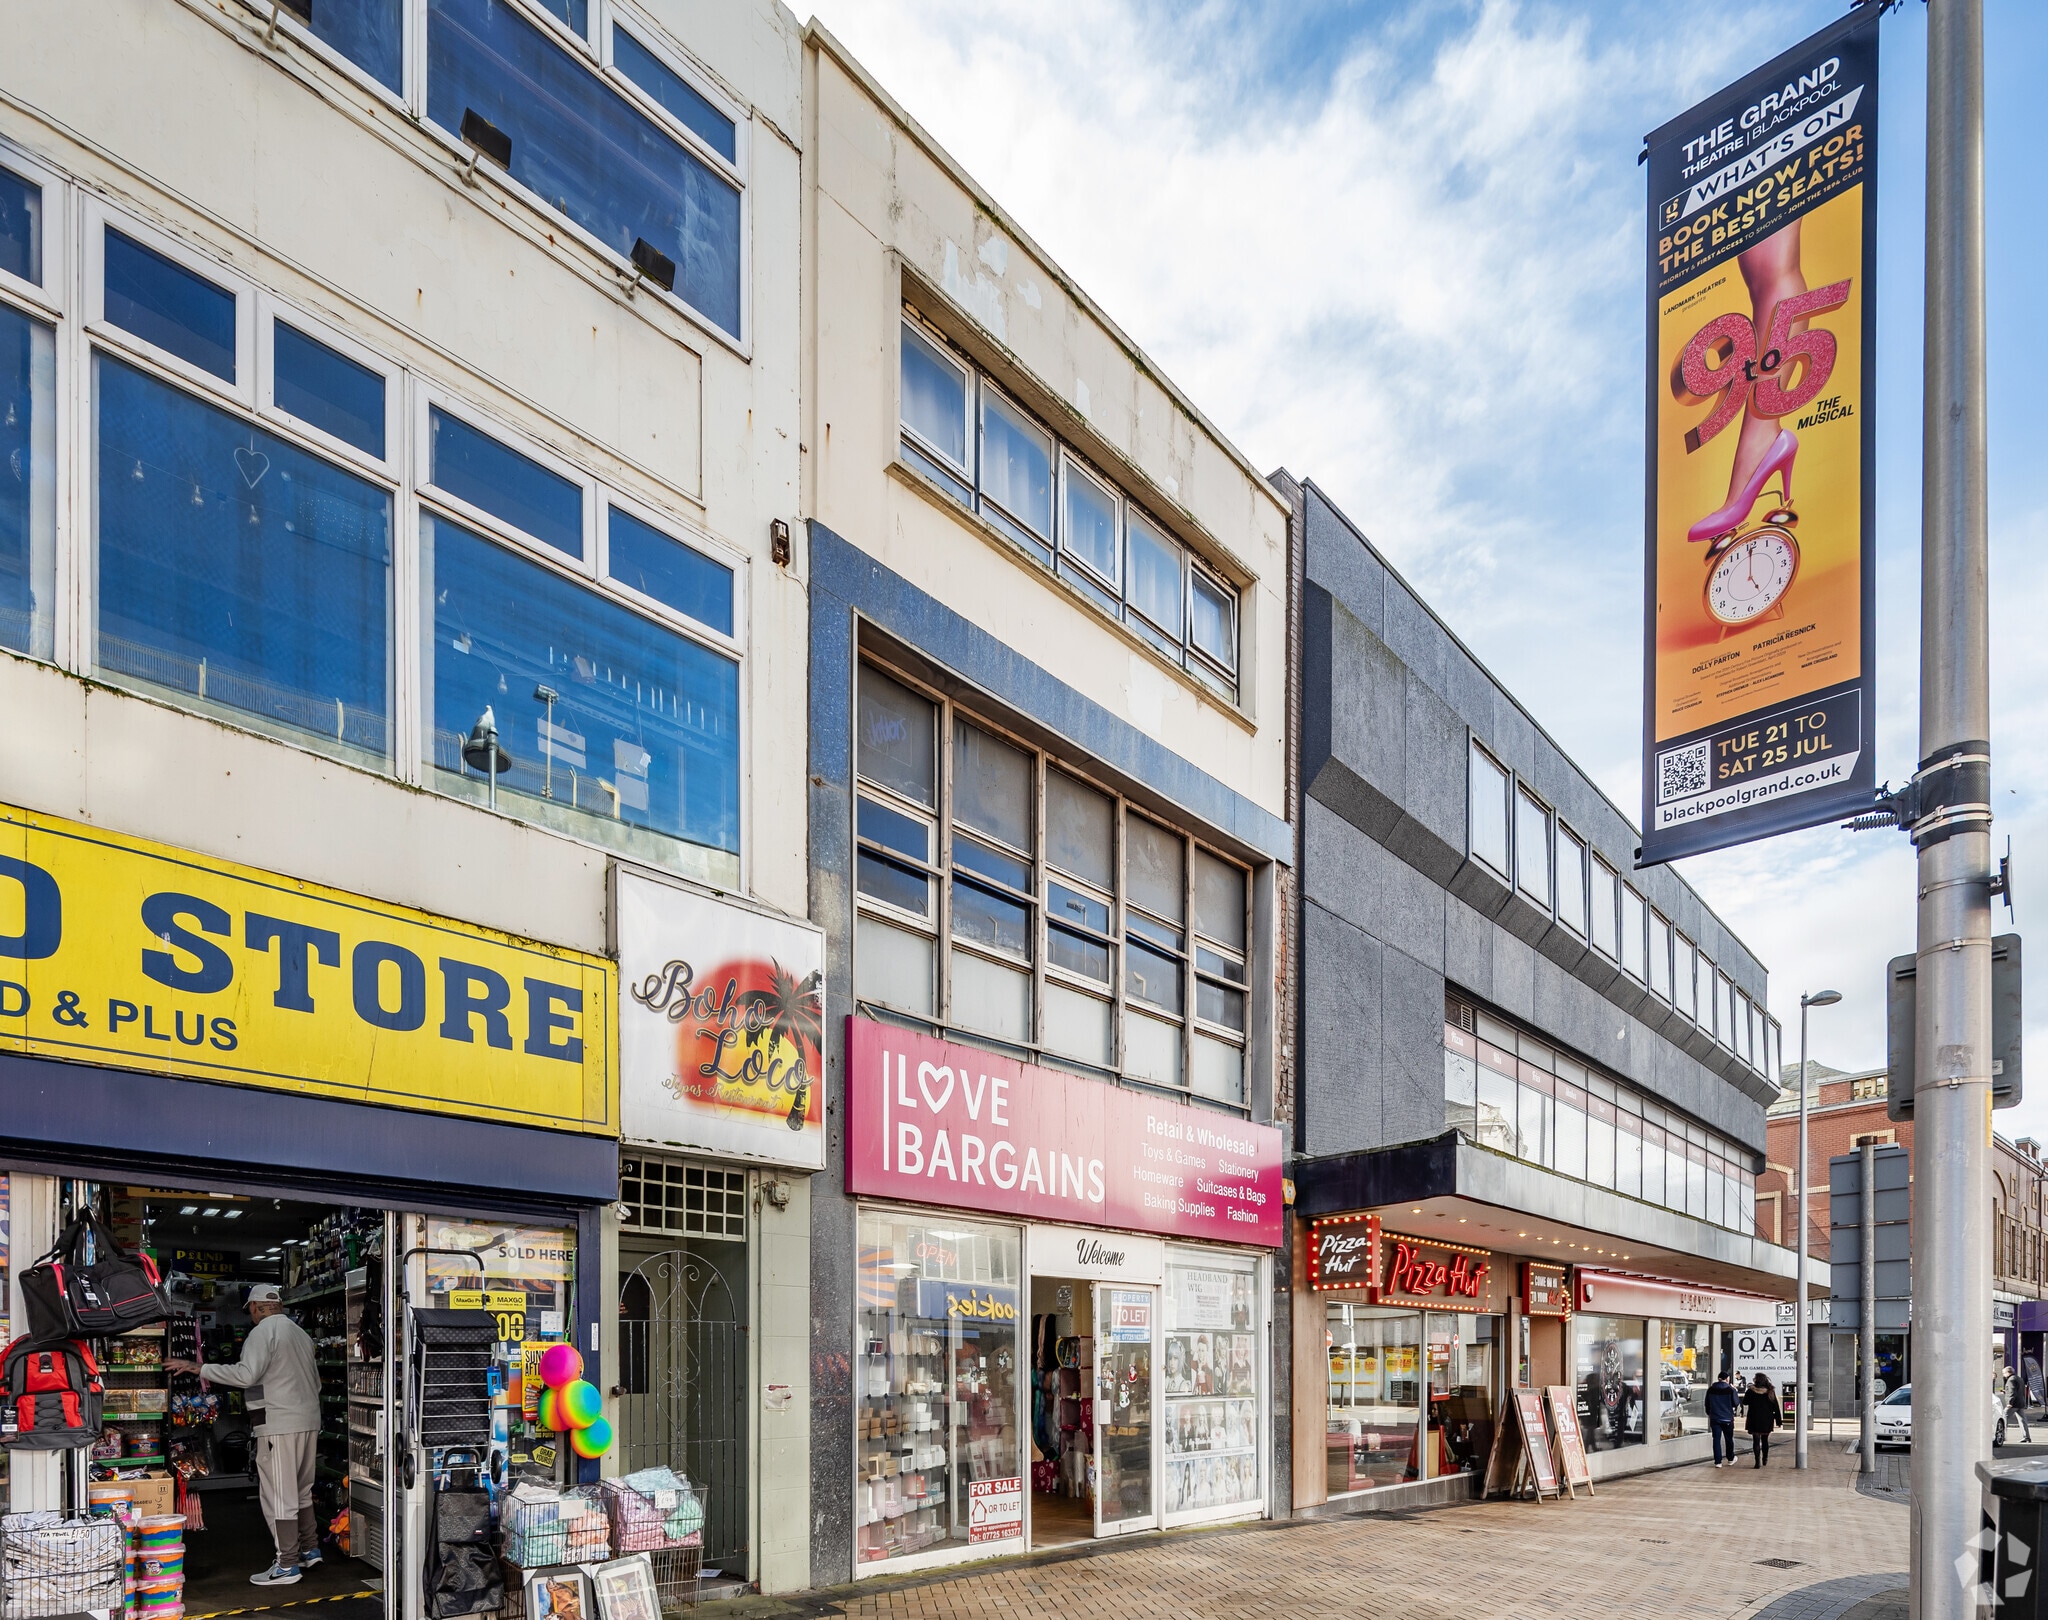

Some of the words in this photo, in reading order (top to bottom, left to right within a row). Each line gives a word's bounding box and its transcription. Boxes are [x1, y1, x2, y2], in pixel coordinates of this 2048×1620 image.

[1682, 118, 1734, 163] THE
[1740, 56, 1840, 129] GRAND
[1682, 136, 1743, 179] THEATRE
[1753, 80, 1841, 140] BLACKPOOL
[1697, 133, 1794, 202] WHAT'S
[1804, 102, 1843, 138] ON
[1659, 202, 1728, 256] BOOK
[1736, 157, 1802, 212] NOW
[1808, 124, 1863, 168] FOR
[1659, 237, 1704, 275] THE
[1712, 199, 1771, 247] BEST
[1777, 142, 1863, 208] SEATS!
[1659, 266, 1690, 289] PRIORITY
[1696, 252, 1715, 264] FIRST
[1716, 237, 1743, 256] ACCESS
[1745, 231, 1755, 240] TO
[1756, 213, 1783, 234] SHOWS
[1788, 199, 1806, 214] JOIN
[1807, 190, 1822, 203] THE
[1823, 179, 1841, 193] 1894
[1842, 166, 1863, 181] CLUB
[1664, 294, 1696, 316] LANDMARK
[1696, 277, 1727, 300] THEATRES
[1742, 349, 1781, 381] to
[1754, 277, 1853, 420] 5
[1671, 312, 1759, 455] 9
[1816, 395, 1841, 413] THE
[1797, 404, 1854, 430] MUSICAL
[1753, 635, 1784, 651] PATRICIA
[1785, 623, 1816, 640] RESNICK
[1692, 661, 1713, 674] DOLLY
[1713, 651, 1740, 666] PARTON
[1718, 731, 1759, 757] TUE
[1766, 722, 1788, 743] 21
[1795, 711, 1827, 734] TO
[1718, 754, 1759, 780] SAT
[1761, 746, 1788, 768] 25
[1793, 733, 1832, 758] JUL
[1663, 763, 1841, 823] blackpoolgrand.co.uk
[141, 891, 584, 1064] STORE
[631, 960, 774, 1032] Boho
[52, 990, 89, 1029] &
[108, 998, 238, 1051] PLUS
[696, 1028, 814, 1092] Loco
[1147, 1115, 1182, 1140] Retail
[1186, 1125, 1194, 1143] &
[1197, 1127, 1255, 1157] Wholesale
[897, 1121, 1105, 1203] BARGAINS
[1142, 1142, 1164, 1162] Toys
[1166, 1148, 1174, 1162] &
[1174, 1149, 1206, 1169] Games
[1218, 1159, 1259, 1183] Stationery
[1133, 1165, 1184, 1188] Homeware
[1197, 1177, 1237, 1199] Suitcases
[1239, 1186, 1246, 1200] &
[1247, 1188, 1266, 1206] Bags
[1144, 1192, 1176, 1214] Baking
[1178, 1198, 1215, 1218] Supplies
[1227, 1206, 1258, 1224] Fashion
[499, 1246, 536, 1260] SOLD
[540, 1249, 573, 1262] HERE
[915, 1242, 957, 1267] OPEN
[1076, 1238, 1125, 1267] Welcome
[1320, 1233, 1367, 1257] Pizza
[1325, 1254, 1361, 1274] Hut
[1187, 1272, 1228, 1284] HEADBAND
[1187, 1283, 1203, 1292] WIG
[1385, 1241, 1447, 1296] Pizza
[1446, 1252, 1488, 1298] Hut
[1113, 1293, 1149, 1302] PROPERTY
[1117, 1309, 1128, 1322] TO
[1130, 1309, 1145, 1322] LET
[971, 1483, 992, 1496] FOR
[995, 1480, 1020, 1493] SALE
[988, 1504, 997, 1513] OR
[999, 1503, 1007, 1512] TO
[1009, 1502, 1020, 1510] LET
[970, 1534, 981, 1542] Tel:
[982, 1531, 1000, 1540] 07725
